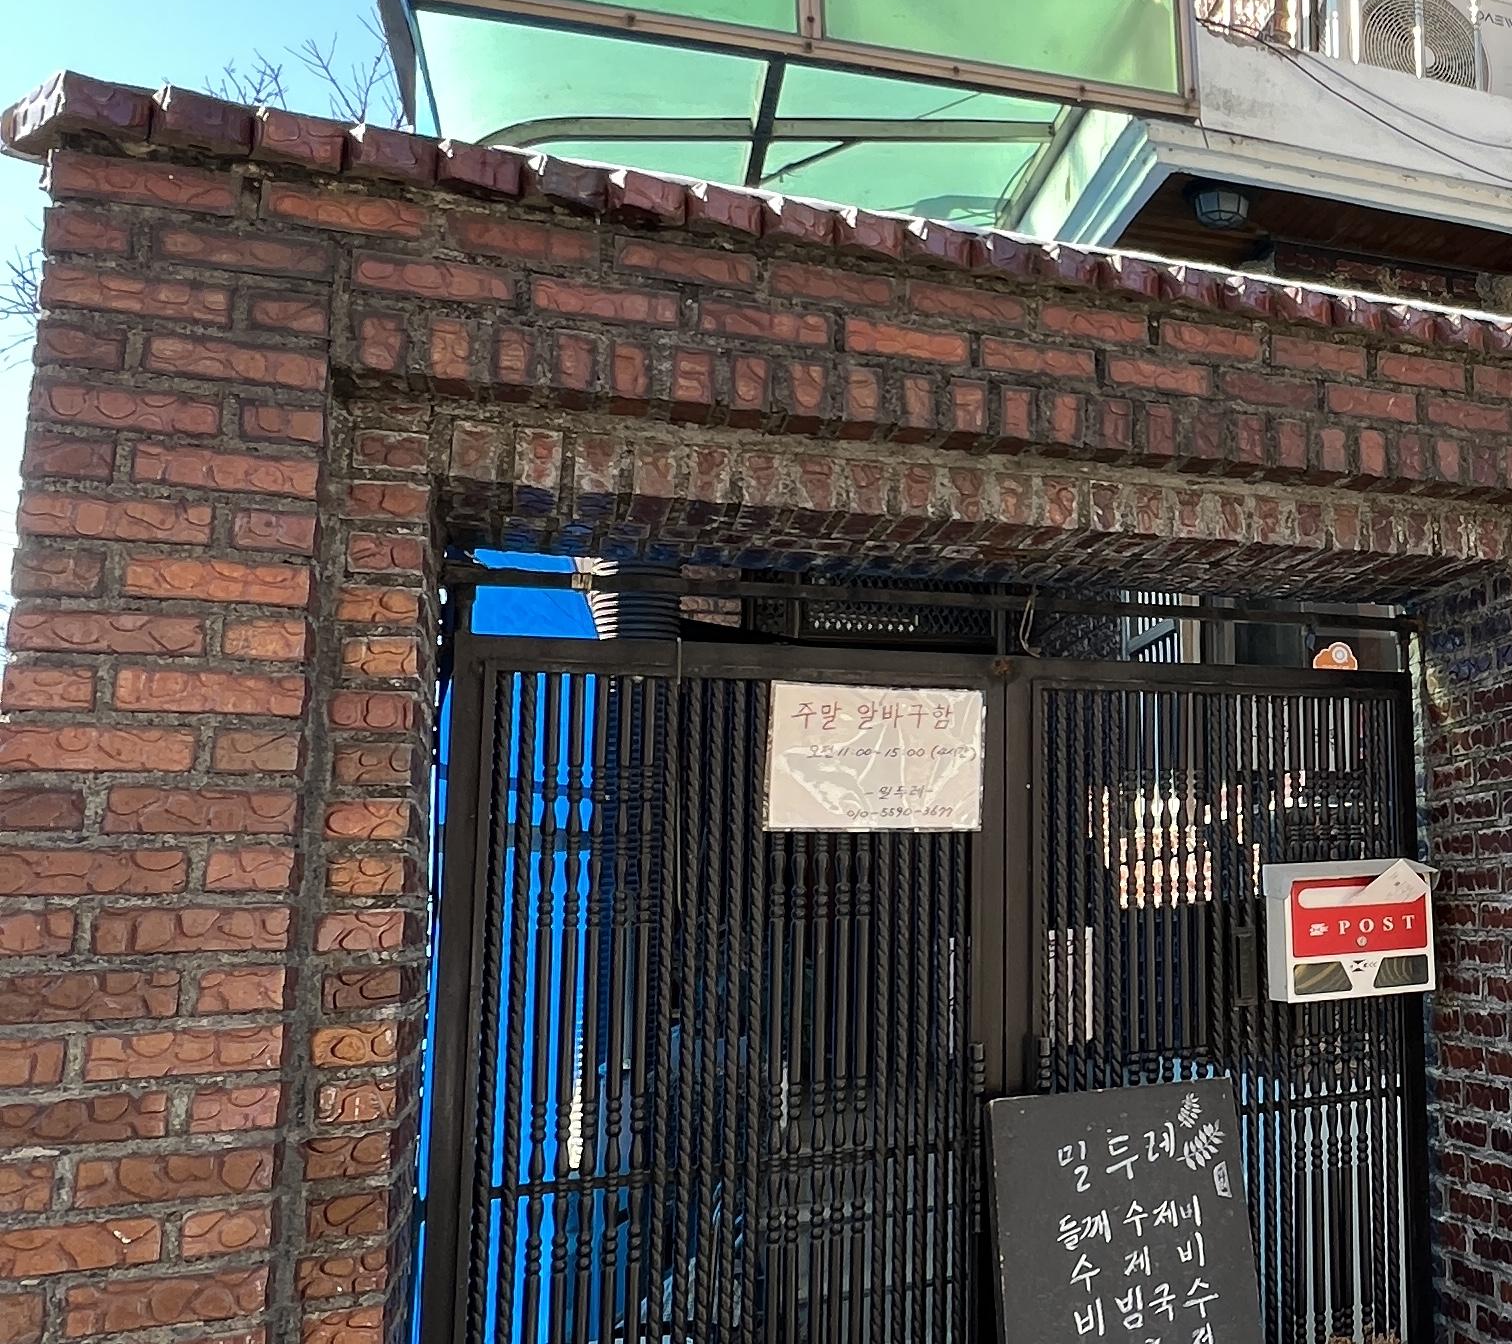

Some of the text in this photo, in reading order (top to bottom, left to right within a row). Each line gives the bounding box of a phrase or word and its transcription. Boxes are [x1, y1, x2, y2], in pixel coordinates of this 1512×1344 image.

[791, 700, 954, 731] 주말 알바구함
[1337, 914, 1416, 936] POST
[1057, 1122, 1176, 1193] 밀두레
[1056, 1194, 1203, 1251] 들깨 수제비
